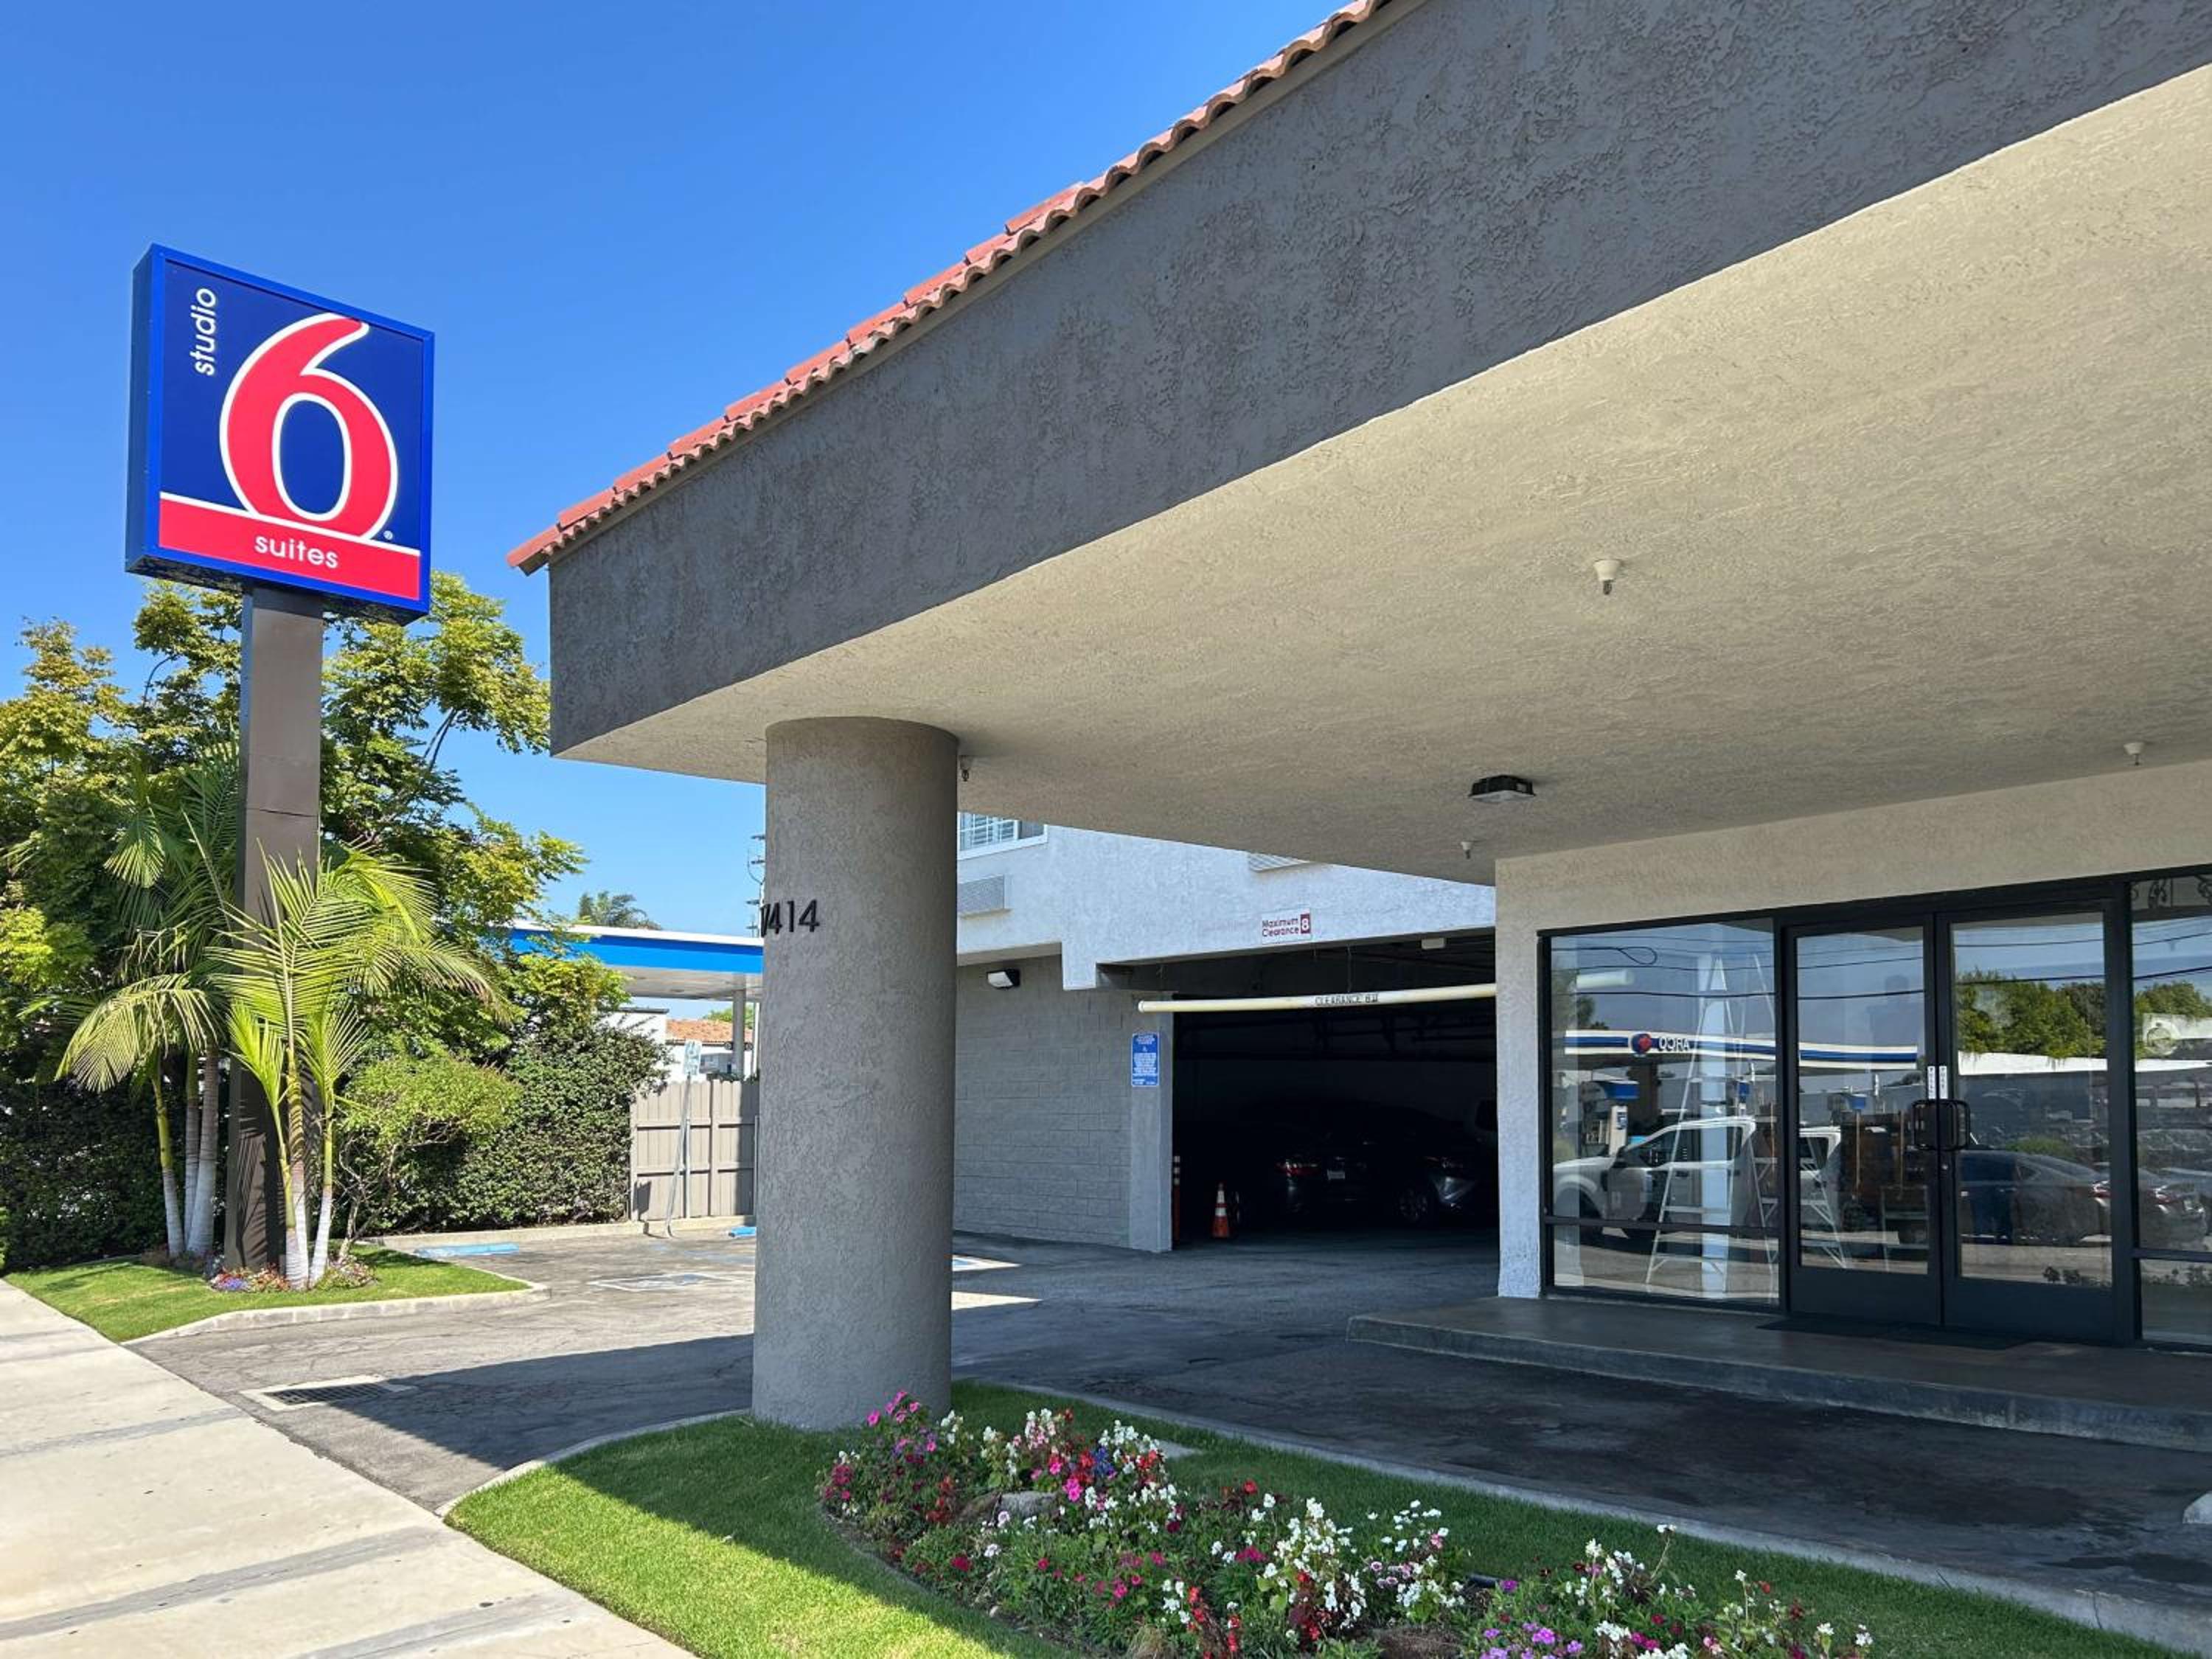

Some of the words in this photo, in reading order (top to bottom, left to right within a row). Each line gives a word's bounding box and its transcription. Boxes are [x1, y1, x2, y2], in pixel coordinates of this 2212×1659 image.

[189, 288, 217, 375] studio
[220, 311, 399, 540] 6
[254, 535, 339, 569] suites
[1262, 927, 1299, 937] Clearance
